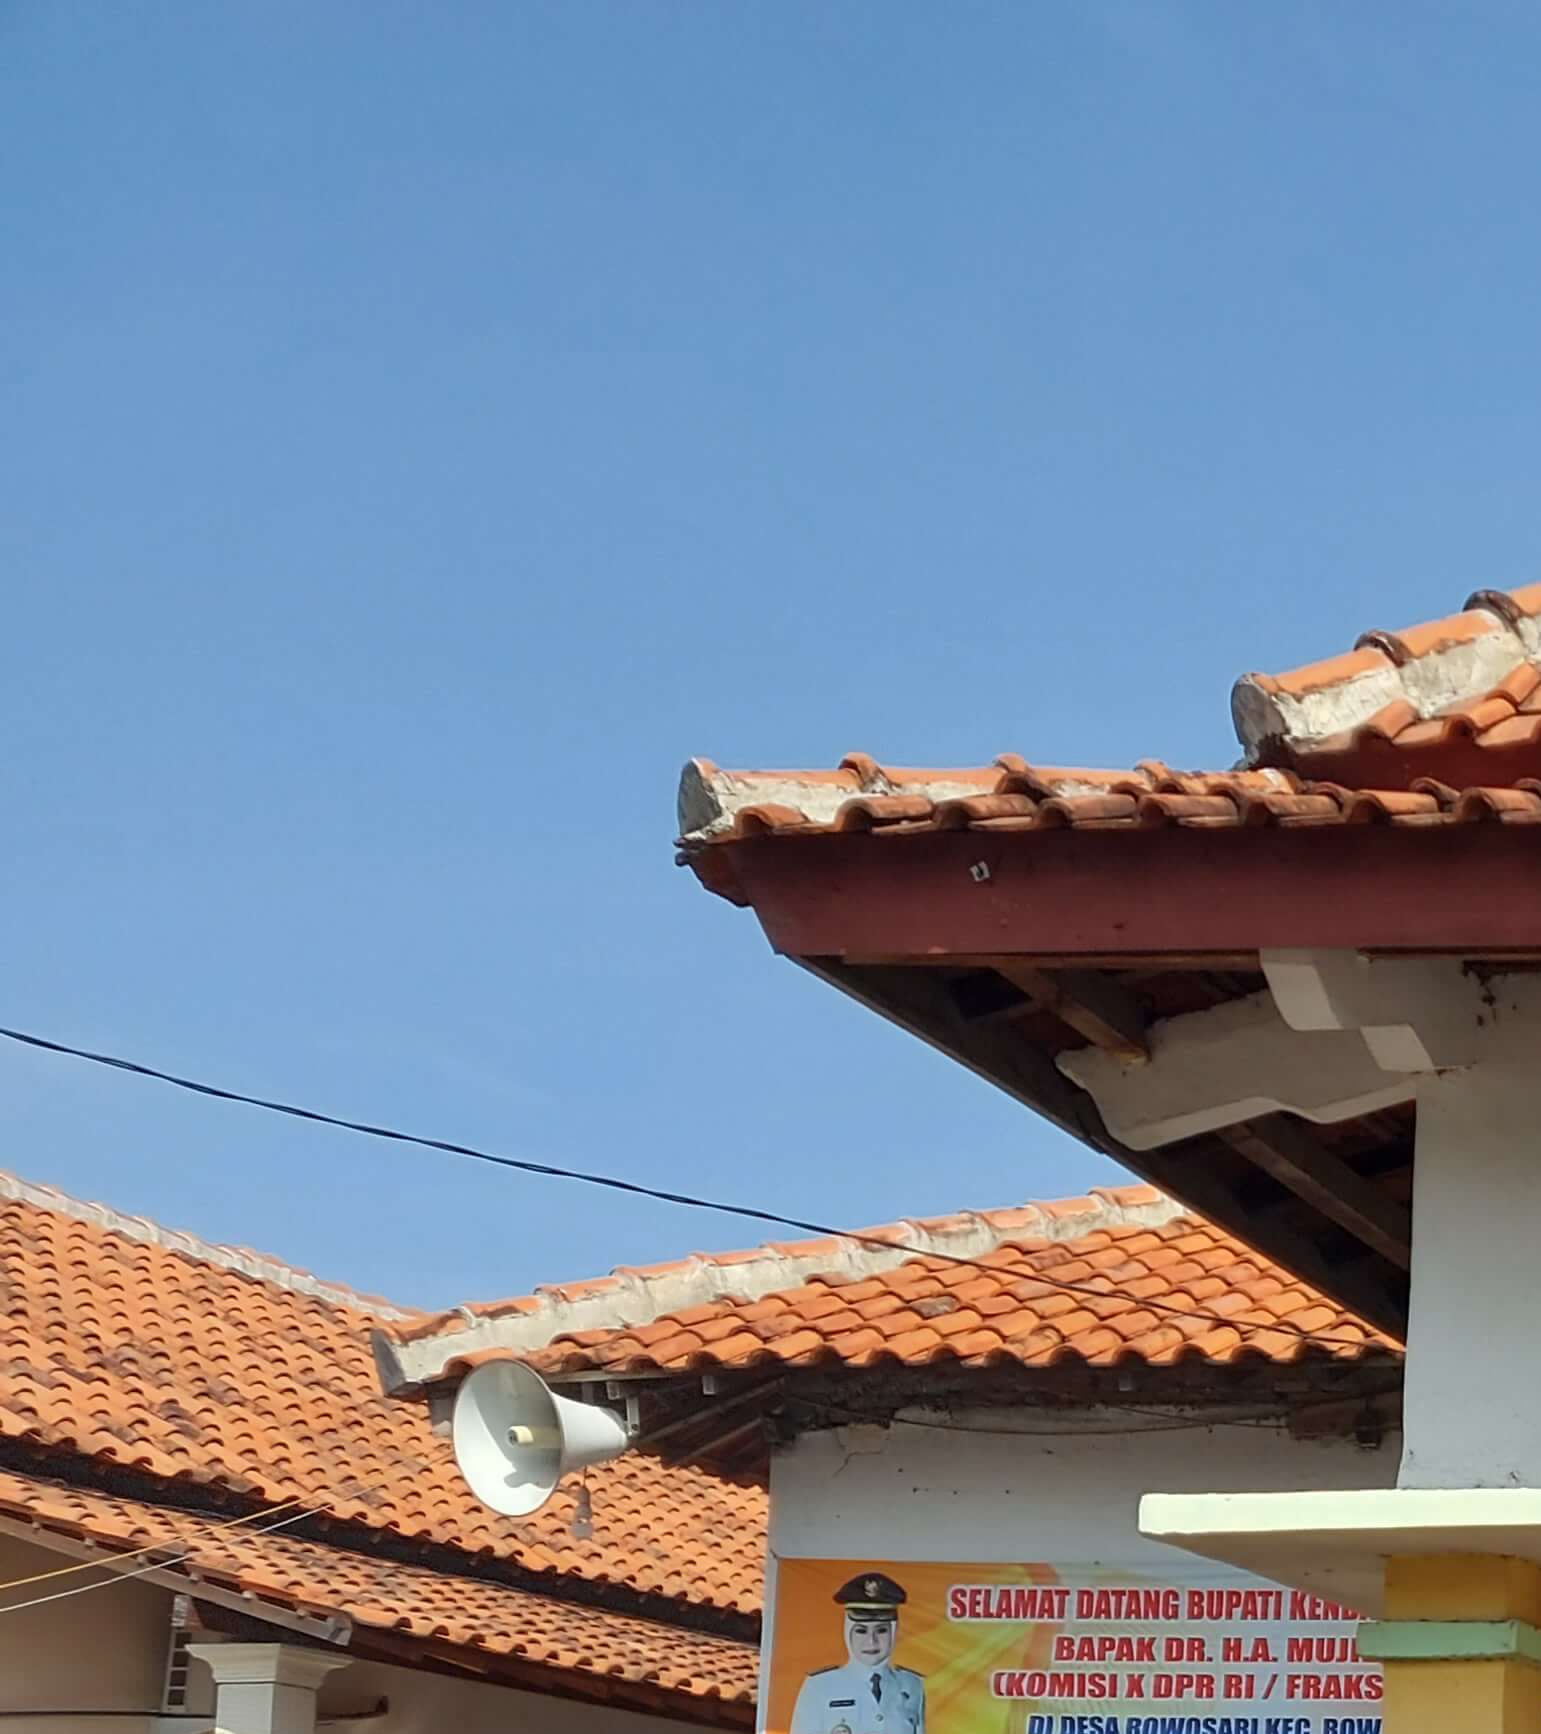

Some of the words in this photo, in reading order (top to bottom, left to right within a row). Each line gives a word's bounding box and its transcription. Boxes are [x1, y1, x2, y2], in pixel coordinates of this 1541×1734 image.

[949, 1587, 1070, 1620] SELAMAT
[1075, 1589, 1182, 1621] DATANG
[1186, 1589, 1282, 1621] BUPATI
[1289, 1589, 1369, 1621] KEN
[1054, 1636, 1157, 1663] BAPAK
[1164, 1637, 1214, 1663] DR.
[1222, 1637, 1278, 1663] H.A.
[993, 1672, 1118, 1699] (KOMISI
[1125, 1673, 1144, 1698] X
[1152, 1673, 1216, 1699] DPR
[1223, 1673, 1254, 1699] RI
[1261, 1673, 1279, 1699] /
[1285, 1674, 1384, 1699] FRAKS
